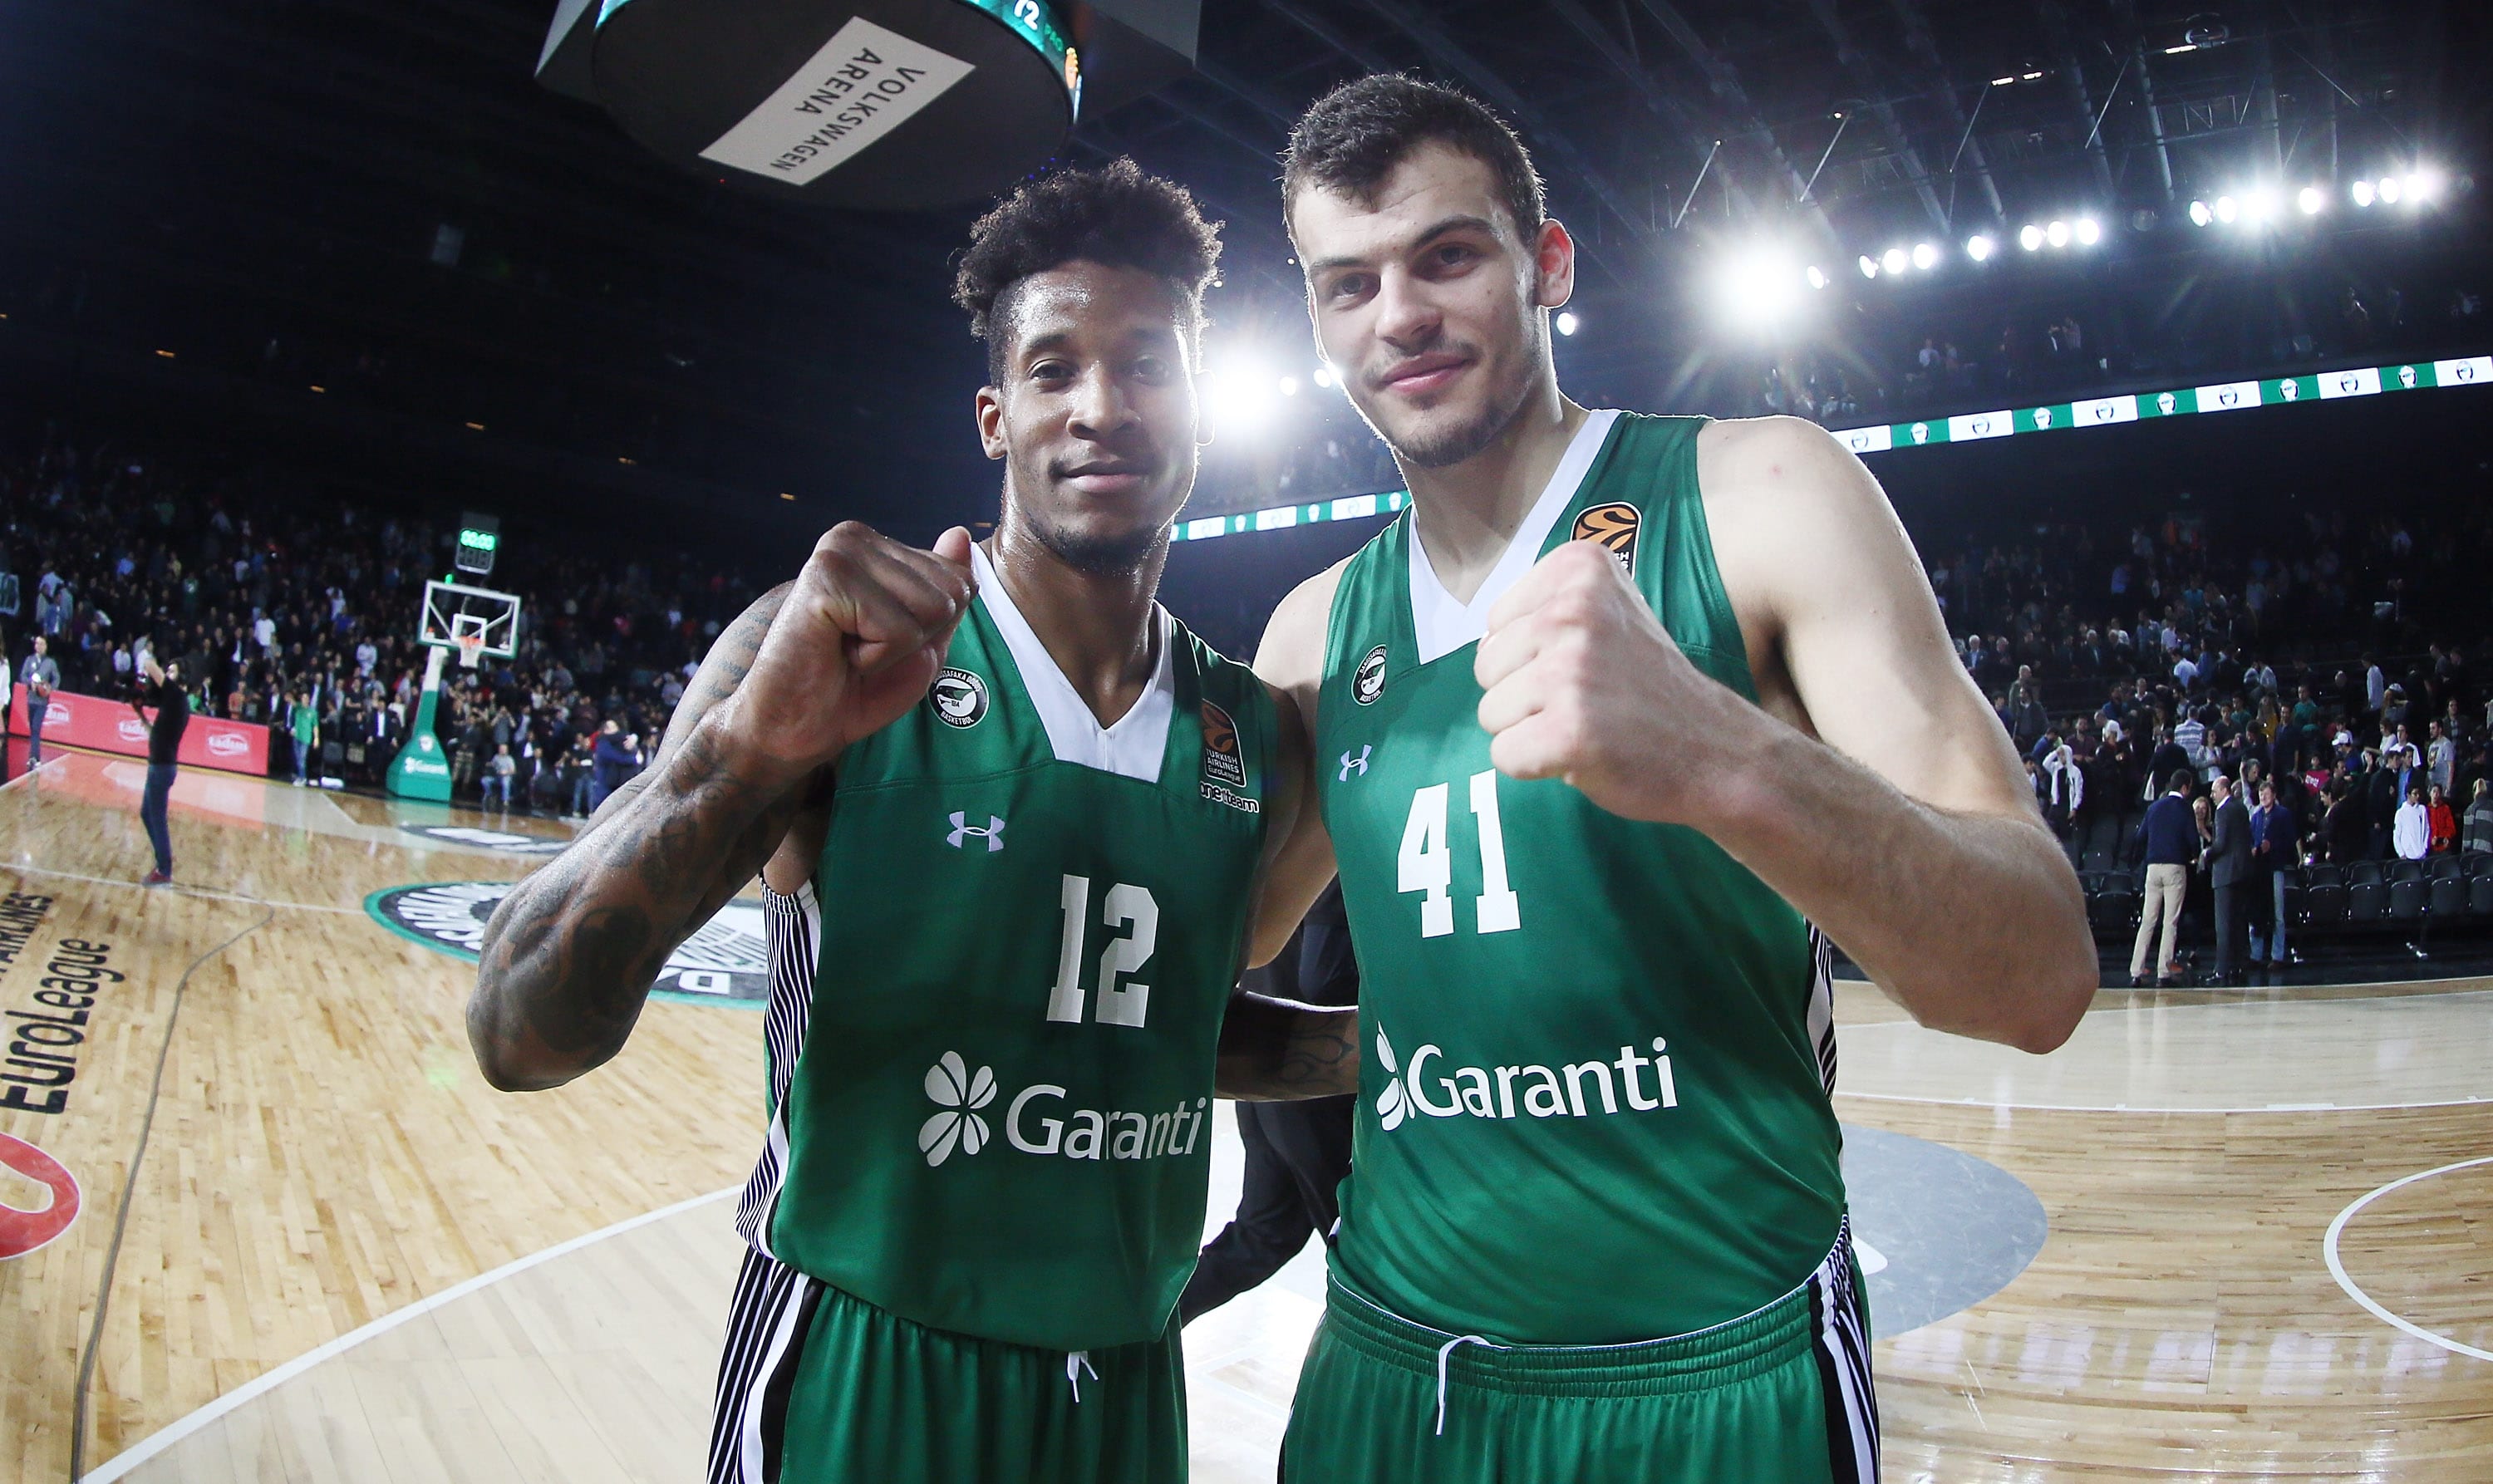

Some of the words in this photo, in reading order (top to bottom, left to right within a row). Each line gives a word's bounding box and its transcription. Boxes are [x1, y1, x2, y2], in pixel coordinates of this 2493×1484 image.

[770, 66, 927, 171] VOLKSWAGEN
[794, 47, 883, 115] ARENA
[940, 710, 975, 725] BASKETBOL
[1206, 749, 1238, 765] TURKISH
[1207, 757, 1240, 774] AIRLINES
[1397, 768, 1522, 939] 41
[1045, 873, 1159, 1029] 12
[0, 939, 125, 1114] EuroLeague
[1407, 1036, 1679, 1119] Garanti
[1006, 1084, 1207, 1161] Garanti
